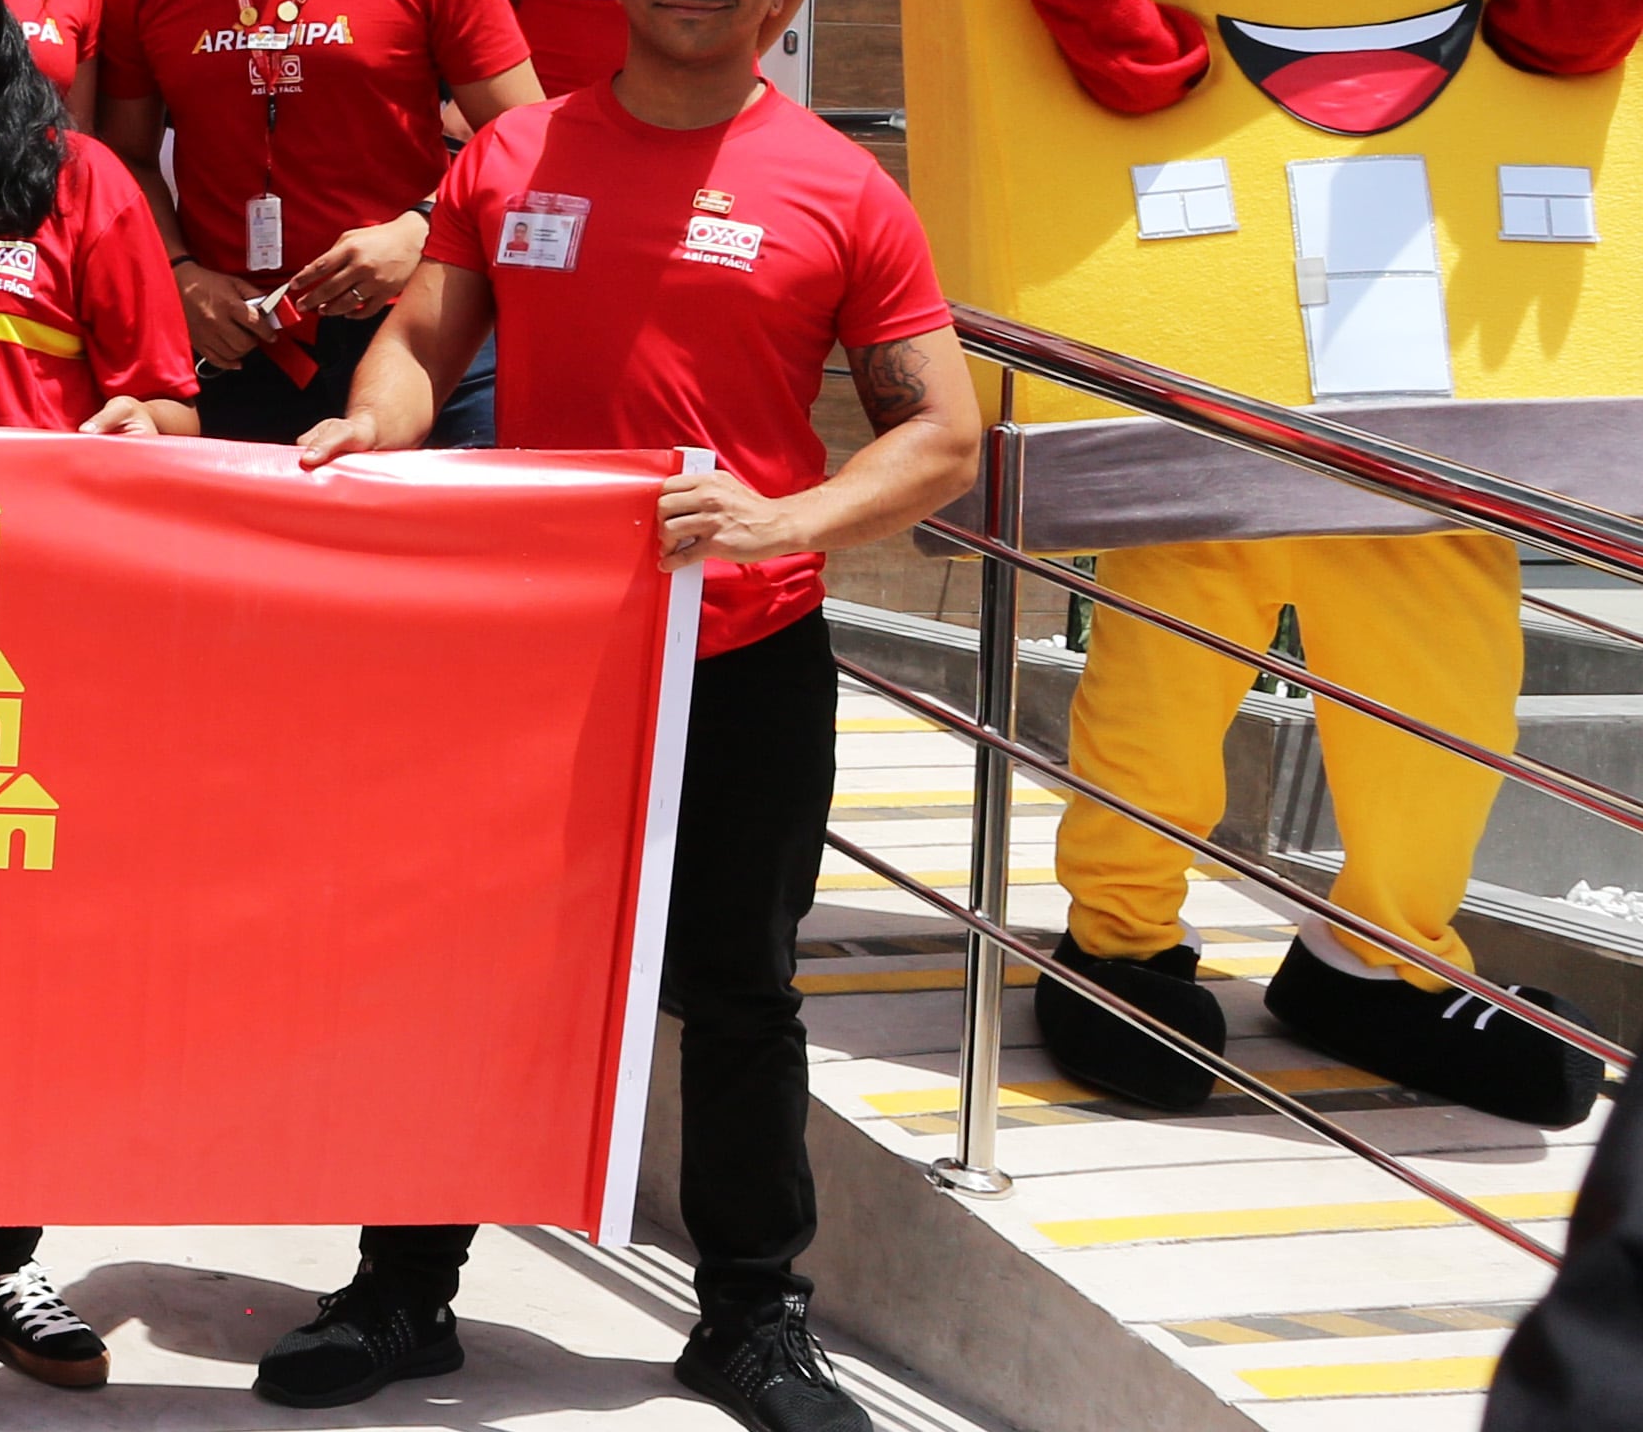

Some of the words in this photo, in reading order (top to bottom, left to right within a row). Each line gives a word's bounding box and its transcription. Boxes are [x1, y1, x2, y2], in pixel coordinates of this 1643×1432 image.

[691, 224, 759, 253] OXXO
[721, 254, 754, 272] FÁCIL
[4, 276, 34, 299] FÁCIL
